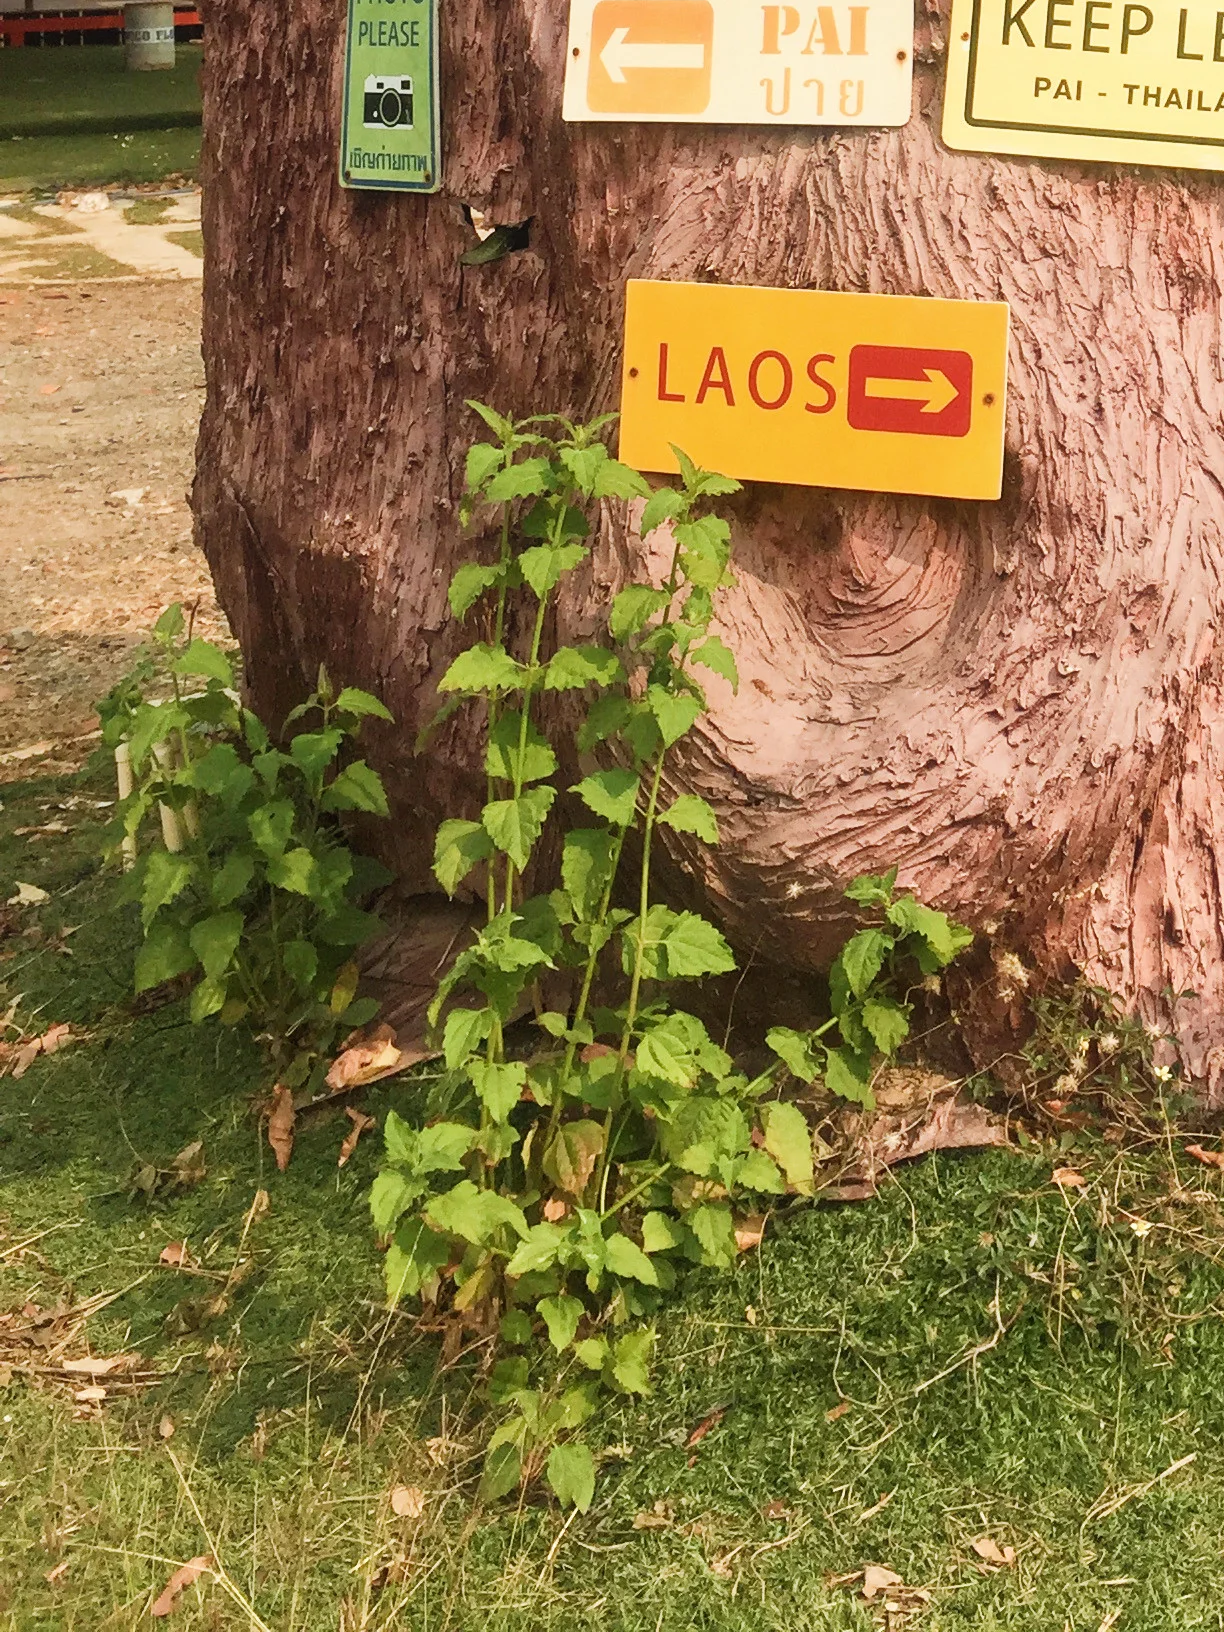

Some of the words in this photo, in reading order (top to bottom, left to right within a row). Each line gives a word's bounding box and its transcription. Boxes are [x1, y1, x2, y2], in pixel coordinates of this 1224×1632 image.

[358, 21, 420, 47] PLEASE
[759, 5, 870, 56] PAI
[759, 67, 865, 117] ปาย
[1033, 76, 1083, 102] PAI
[657, 342, 838, 415] LAOS
